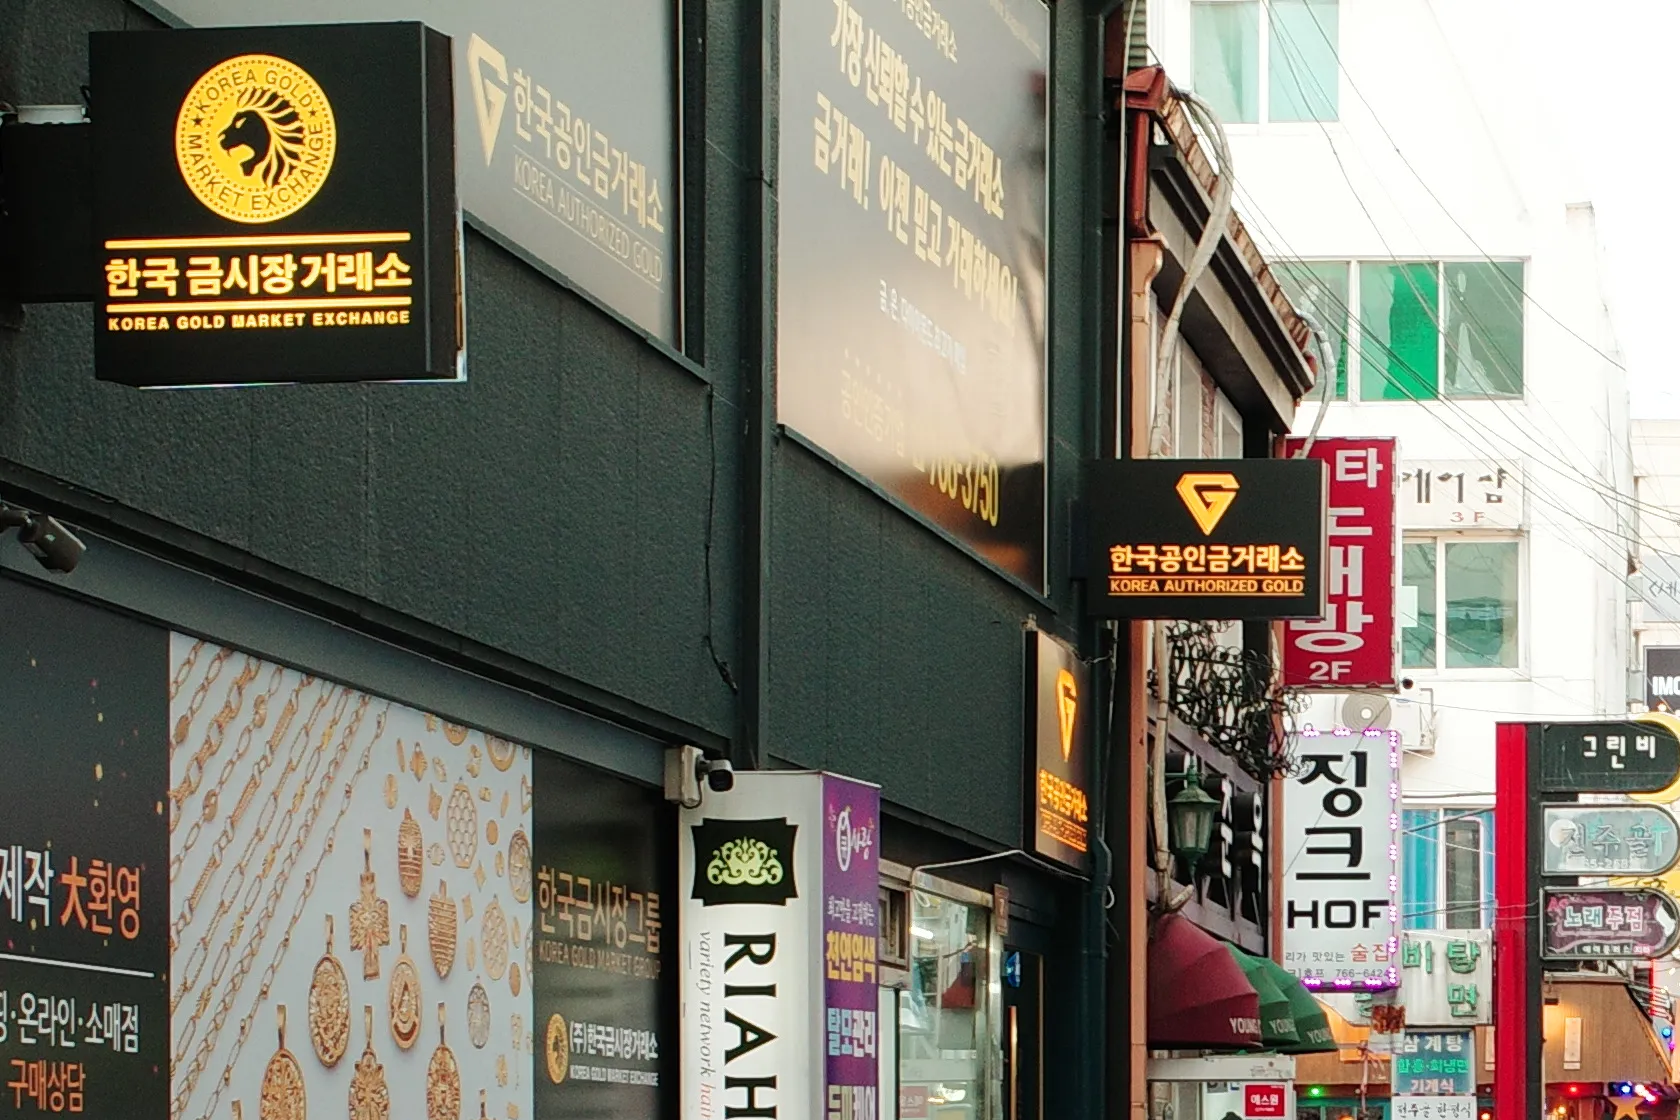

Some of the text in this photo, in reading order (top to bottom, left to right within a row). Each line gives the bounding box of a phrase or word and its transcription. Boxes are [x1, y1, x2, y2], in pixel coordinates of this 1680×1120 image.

[196, 67, 313, 117] KOREA GOLD
[908, 76, 926, 144] 수
[186, 121, 325, 212] MARKET EXCHANGE
[511, 68, 665, 233] 한국공인금거래소
[104, 251, 413, 298] 한국 금시장 거래소
[108, 309, 411, 332] KOREA GOLD MARKET EXCHANGE
[1109, 544, 1306, 574] 한국공인금거래소
[1110, 578, 1305, 594] KOREA AUTHORIZED GOLD
[1308, 660, 1353, 682] 2F
[1582, 734, 1657, 770] 그린비
[1296, 750, 1372, 881] 징크
[536, 864, 662, 954] 한국금시장그룹
[1287, 899, 1390, 929] HOF
[1564, 904, 1644, 932] 노래 주점
[8, 1059, 86, 1113] 구매상담
